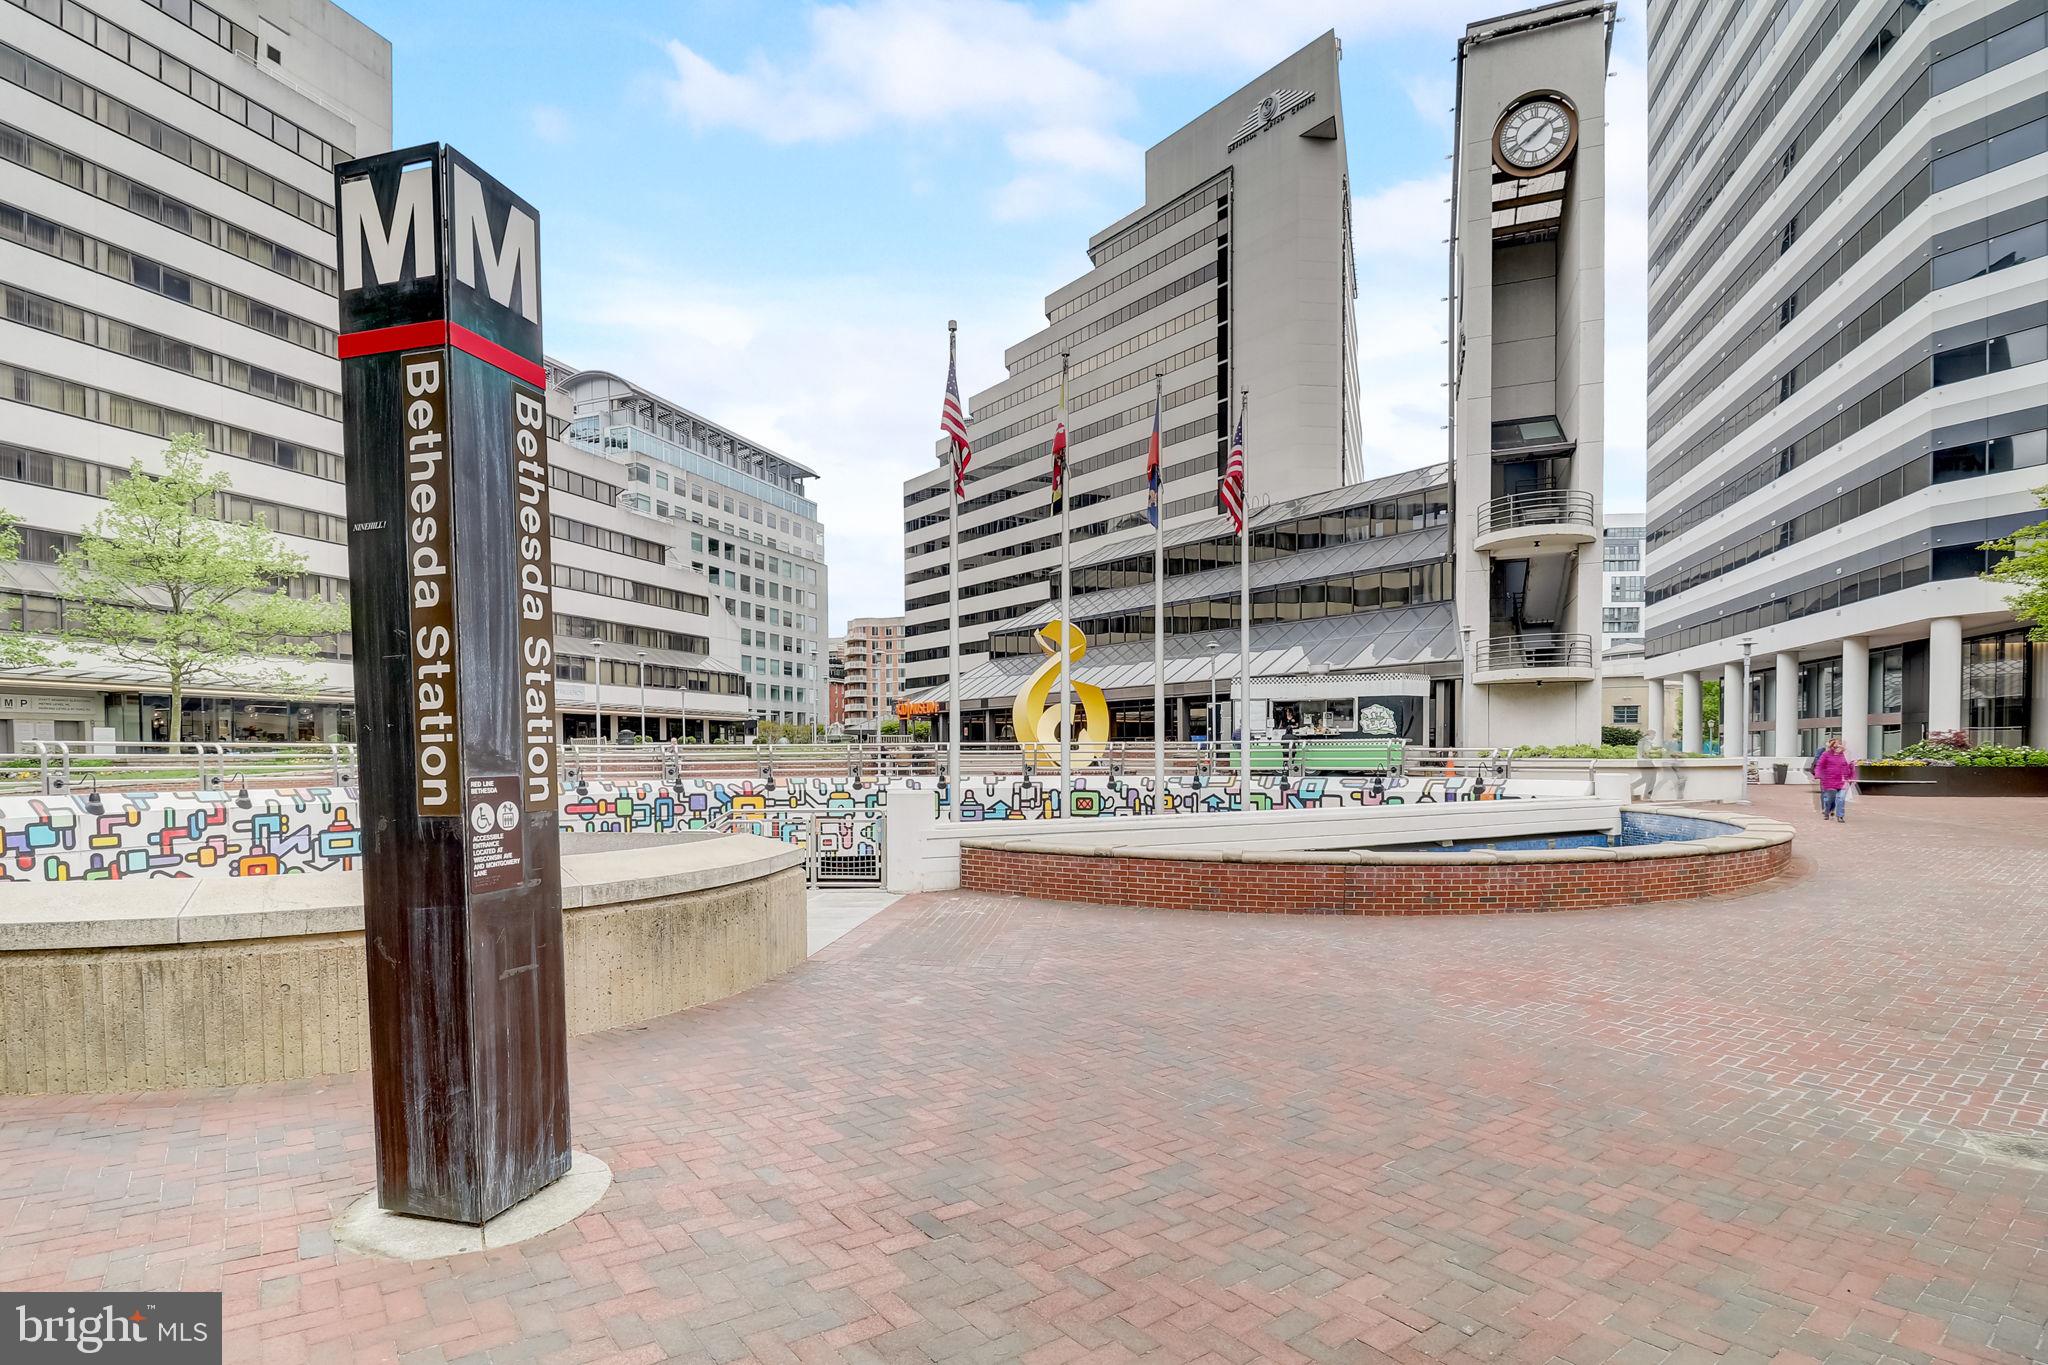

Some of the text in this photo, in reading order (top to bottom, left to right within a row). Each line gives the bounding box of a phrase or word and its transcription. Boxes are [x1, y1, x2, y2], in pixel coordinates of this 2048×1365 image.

[340, 159, 436, 291] M
[453, 162, 538, 325] M
[406, 360, 453, 806] Bethesda Station
[515, 392, 553, 802] Bethesda Station
[20, 699, 28, 708] P
[470, 787, 498, 795] BETHESDA
[473, 833, 504, 842] ACCESSIBLE
[473, 840, 500, 850] ENTRANCE
[473, 847, 496, 857] LOCATED
[473, 854, 503, 864] WISCONSIN
[473, 858, 520, 871] AND MONTGOMERY
[473, 869, 488, 877] LANE
